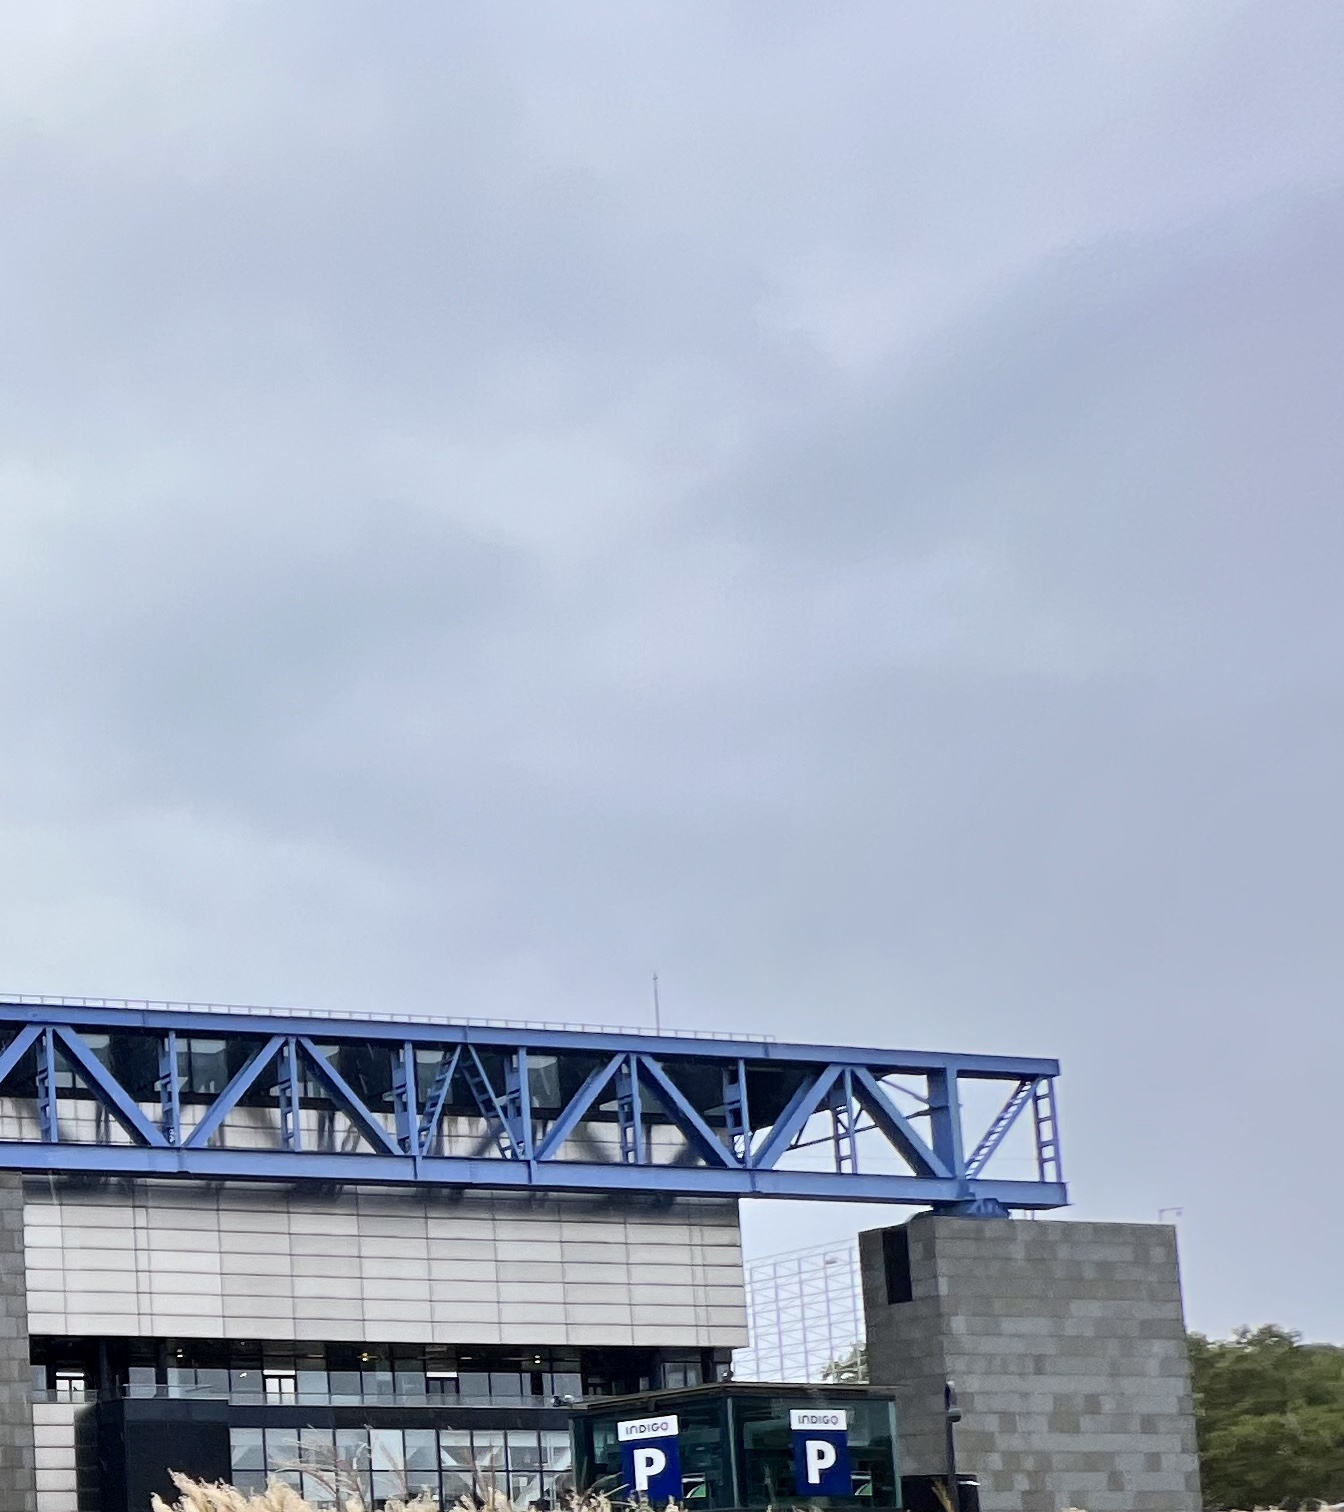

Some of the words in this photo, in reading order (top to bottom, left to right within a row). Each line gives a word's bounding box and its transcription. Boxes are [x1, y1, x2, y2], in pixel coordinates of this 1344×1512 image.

[626, 1422, 669, 1435] INDIGO
[798, 1415, 839, 1425] INDIGO
[633, 1447, 666, 1491] P
[805, 1440, 837, 1484] P
